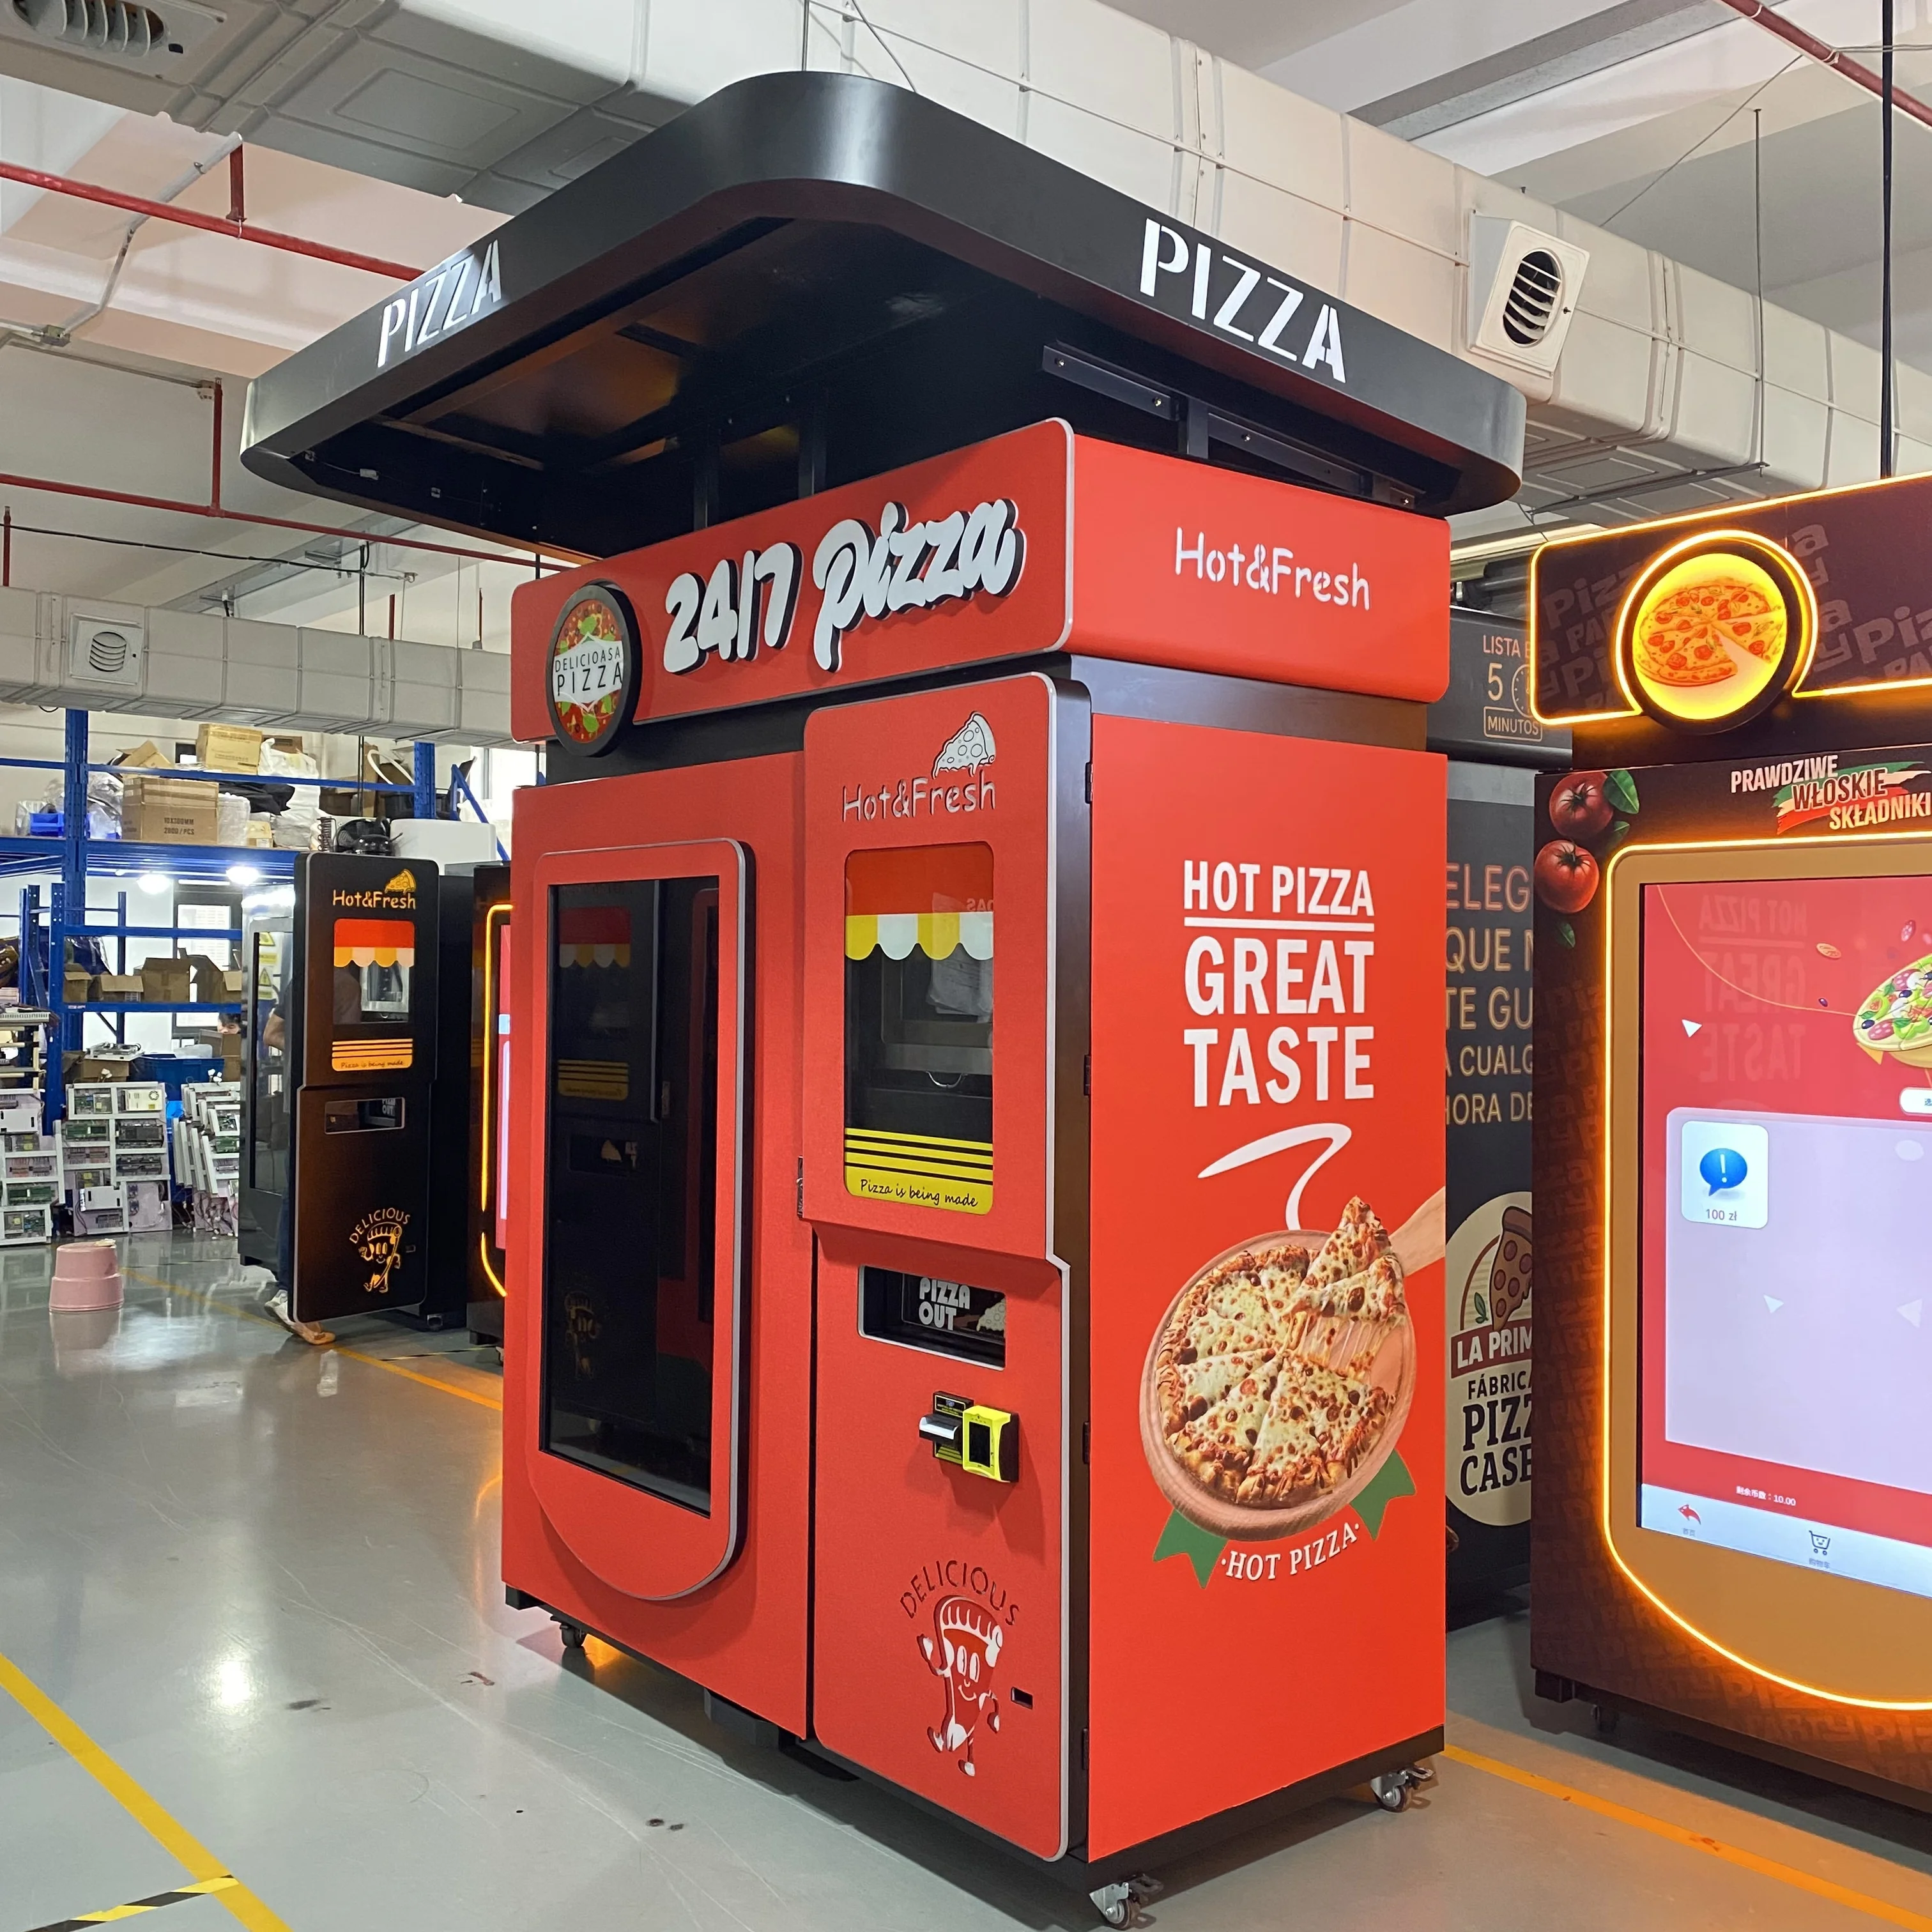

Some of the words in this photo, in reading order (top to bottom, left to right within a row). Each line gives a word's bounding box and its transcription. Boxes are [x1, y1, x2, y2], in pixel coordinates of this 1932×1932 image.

[377, 239, 502, 368] PIZZA
[1140, 218, 1346, 383] PIZZA
[1175, 526, 1370, 611] Hot&Fresh
[555, 646, 621, 673] DELICIOASA
[1483, 634, 1521, 658] LISTA
[556, 662, 623, 696] PIZZA
[1488, 663, 1503, 701] 5
[1487, 716, 1539, 735] MINUTOS
[1731, 755, 1839, 793] PRAWDZIWE
[1791, 767, 1889, 813] WŁOSKIE
[842, 769, 995, 822] Hot&Fresh
[1829, 792, 1931, 830] SKŁADNIKI
[333, 889, 416, 910] Hot&Fresh
[1184, 860, 1261, 912] HOT
[1272, 865, 1374, 916] PIZZA
[1185, 935, 1374, 1016] GREAT
[1184, 1025, 1374, 1107] TASTE
[861, 1179, 893, 1193] Pizza
[896, 1183, 905, 1198] is
[909, 1185, 940, 1206] being
[945, 1193, 978, 1207] made
[349, 1208, 411, 1244] DELICIOUS
[1706, 1209, 1725, 1220] 100
[919, 1277, 970, 1310] PIZZA
[918, 1301, 957, 1331] OUT
[1457, 1336, 1483, 1369] LA
[900, 1560, 1020, 1626] DELICIOUS
